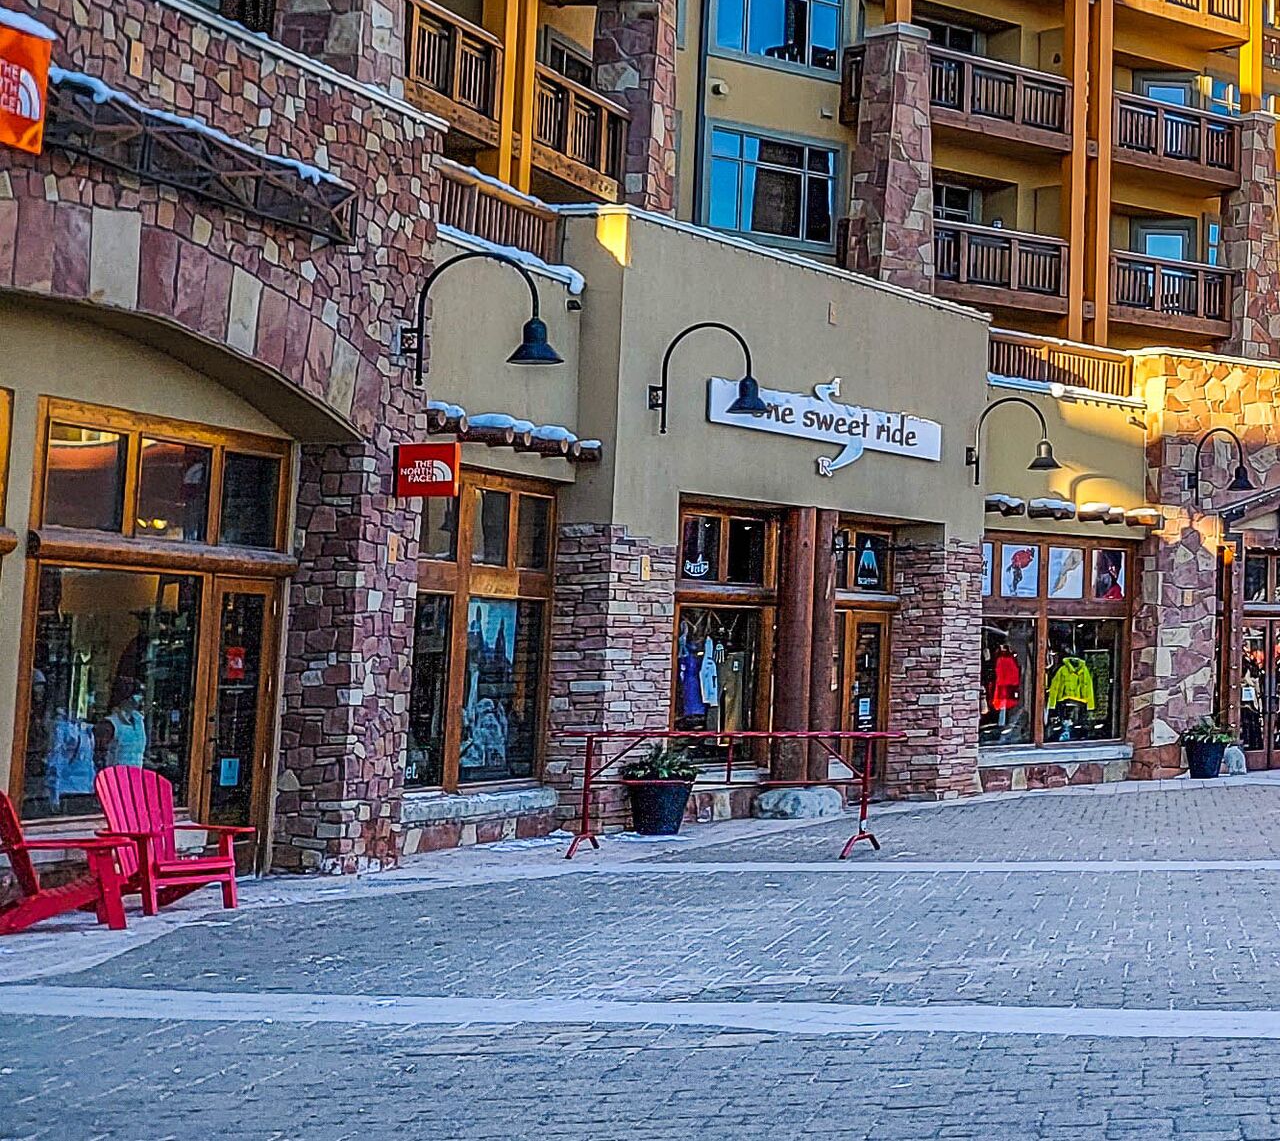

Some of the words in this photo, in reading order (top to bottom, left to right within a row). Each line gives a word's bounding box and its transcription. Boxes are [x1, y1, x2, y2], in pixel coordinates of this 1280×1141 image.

[802, 409, 870, 438] sweet
[876, 411, 918, 447] ride
[400, 467, 433, 475] NORTH
[408, 474, 433, 483] FACE
